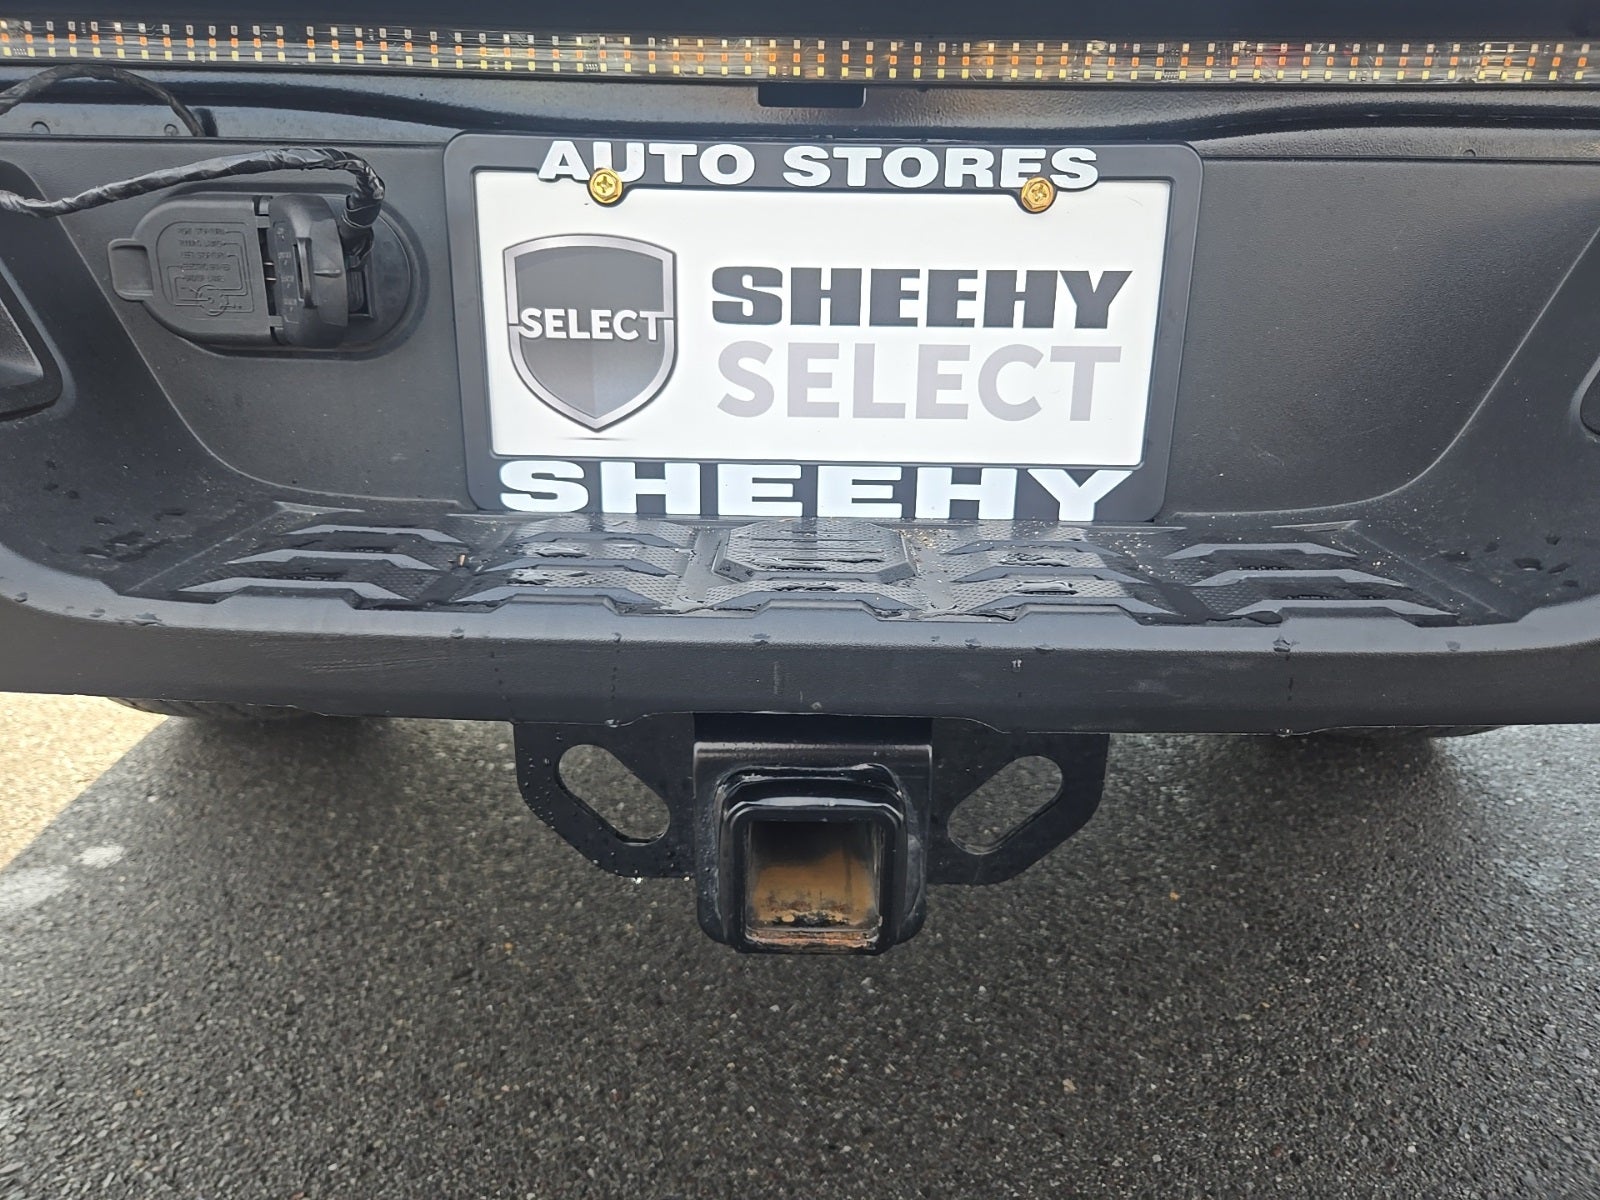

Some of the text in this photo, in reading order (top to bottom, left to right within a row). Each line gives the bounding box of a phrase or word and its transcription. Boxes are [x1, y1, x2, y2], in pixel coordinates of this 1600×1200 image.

[538, 140, 1099, 190] AUTO STORES
[519, 307, 666, 342] SELECT
[712, 266, 1133, 329] SHEEHY
[717, 340, 1121, 421] SELECT
[499, 460, 1134, 521] SHEEHY
